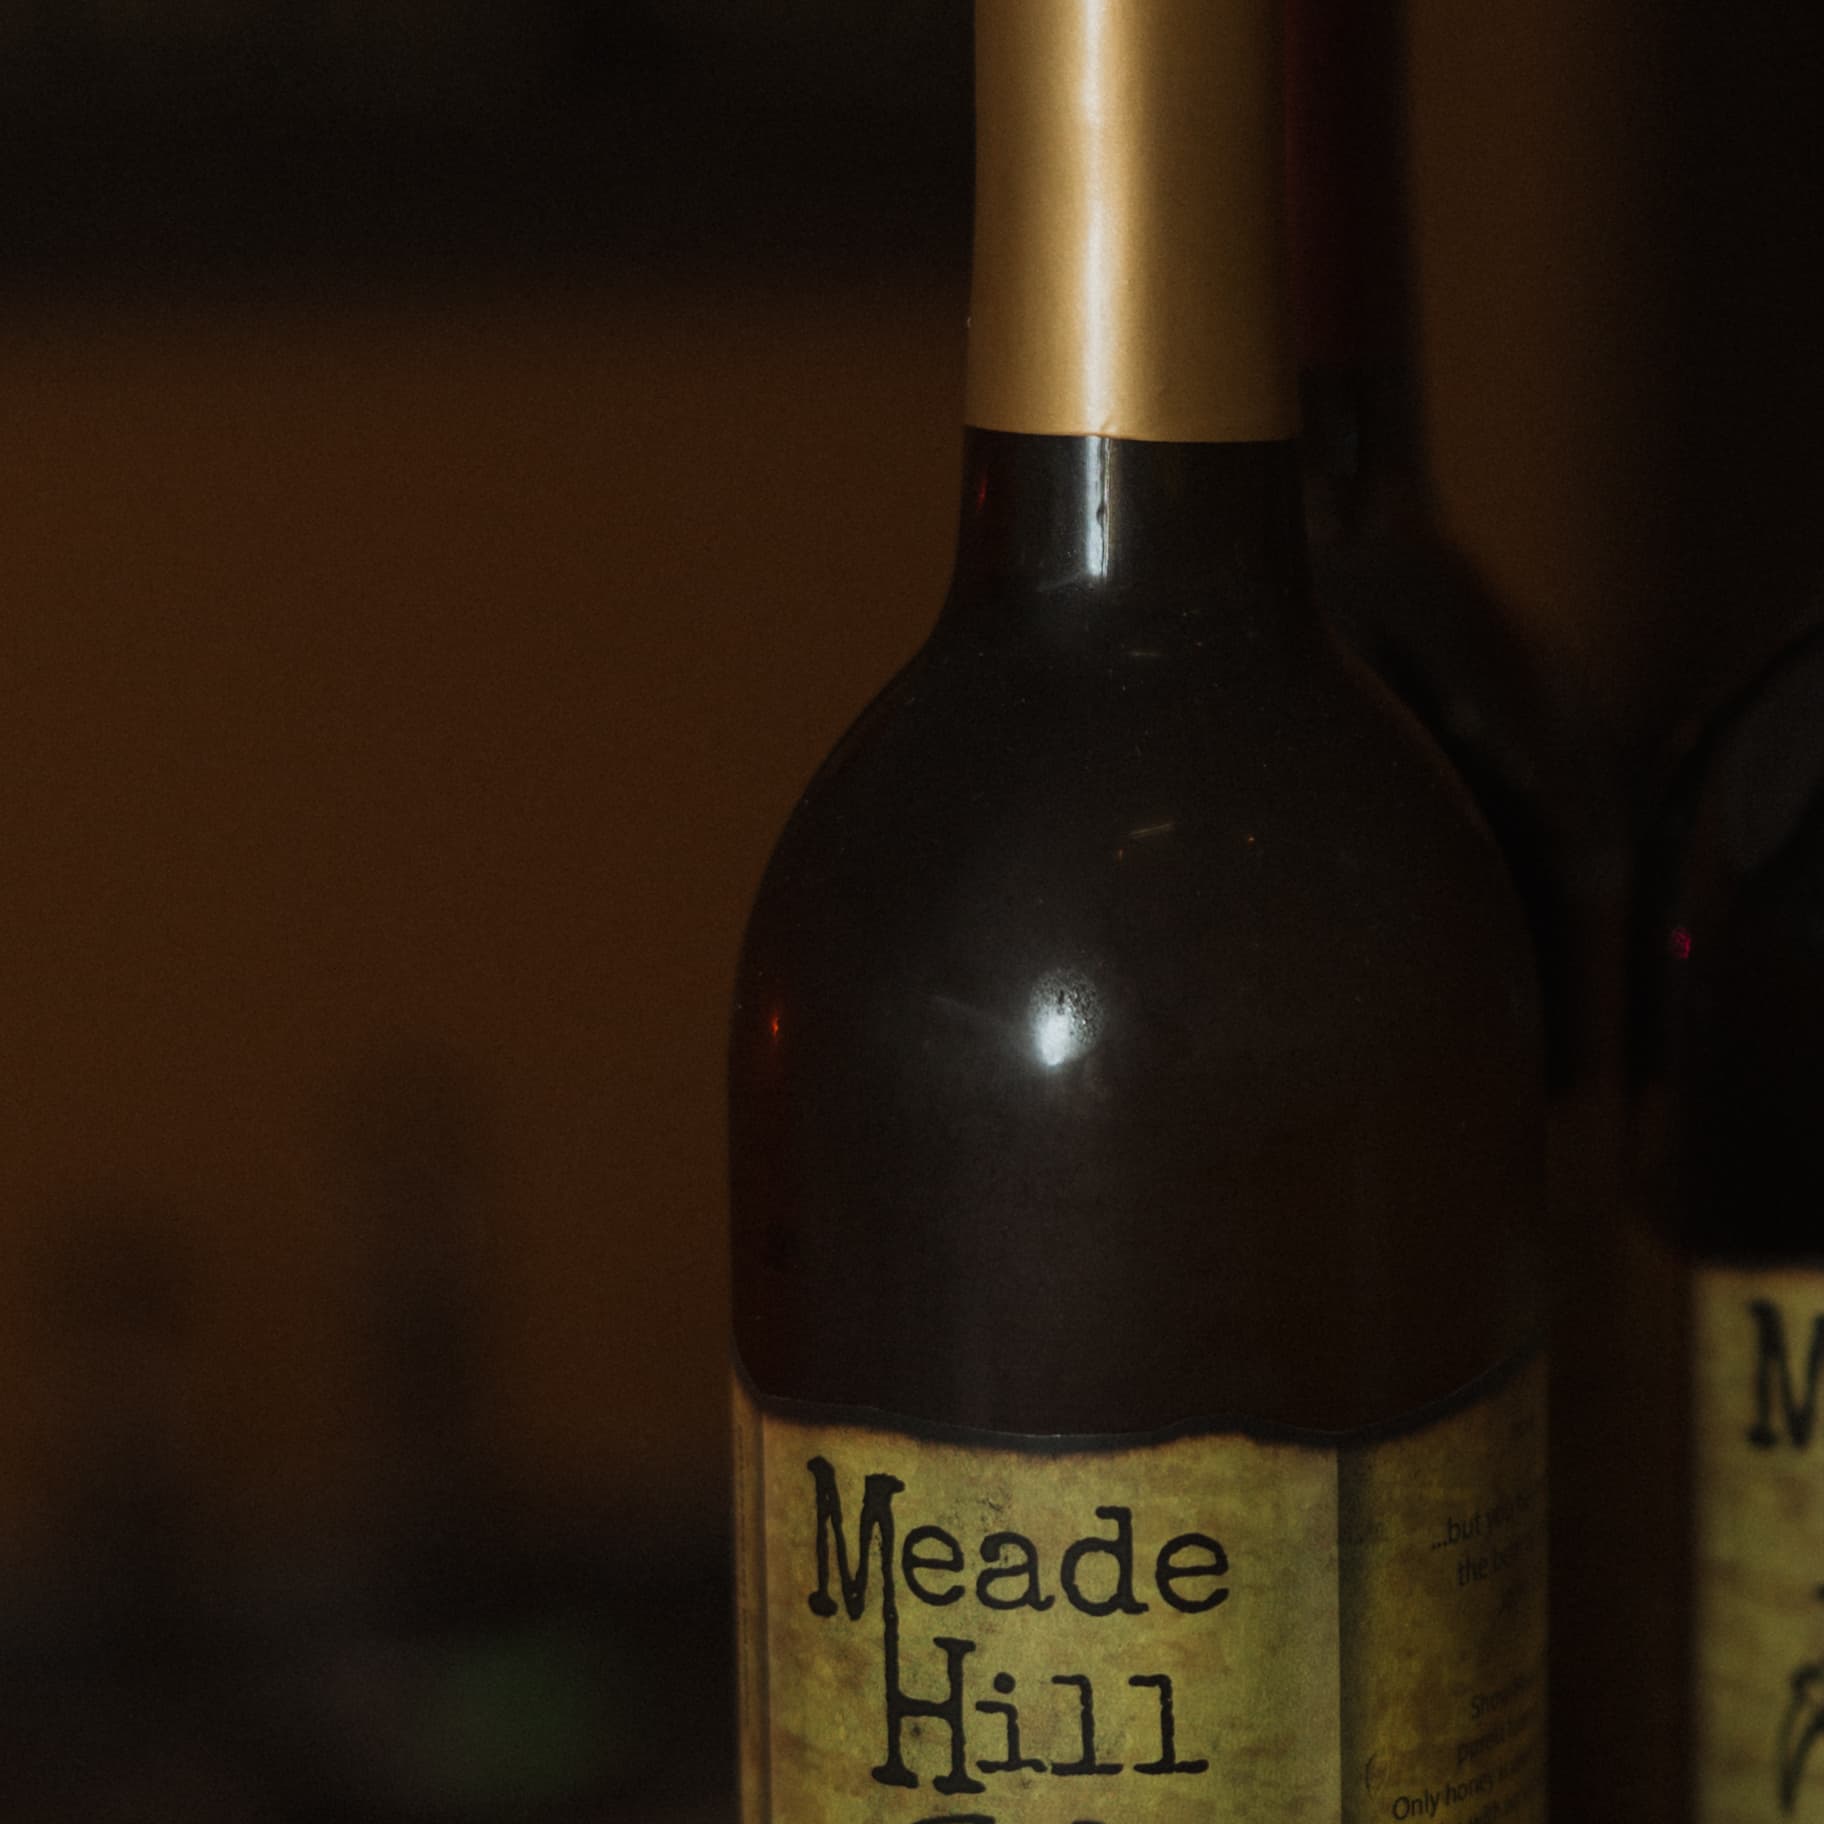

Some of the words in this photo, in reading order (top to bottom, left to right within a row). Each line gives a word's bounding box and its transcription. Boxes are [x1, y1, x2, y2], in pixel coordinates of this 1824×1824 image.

[806, 1455, 1232, 1623] Meade
[871, 1636, 1210, 1795] Hill
[1391, 1789, 1441, 1821] Only
